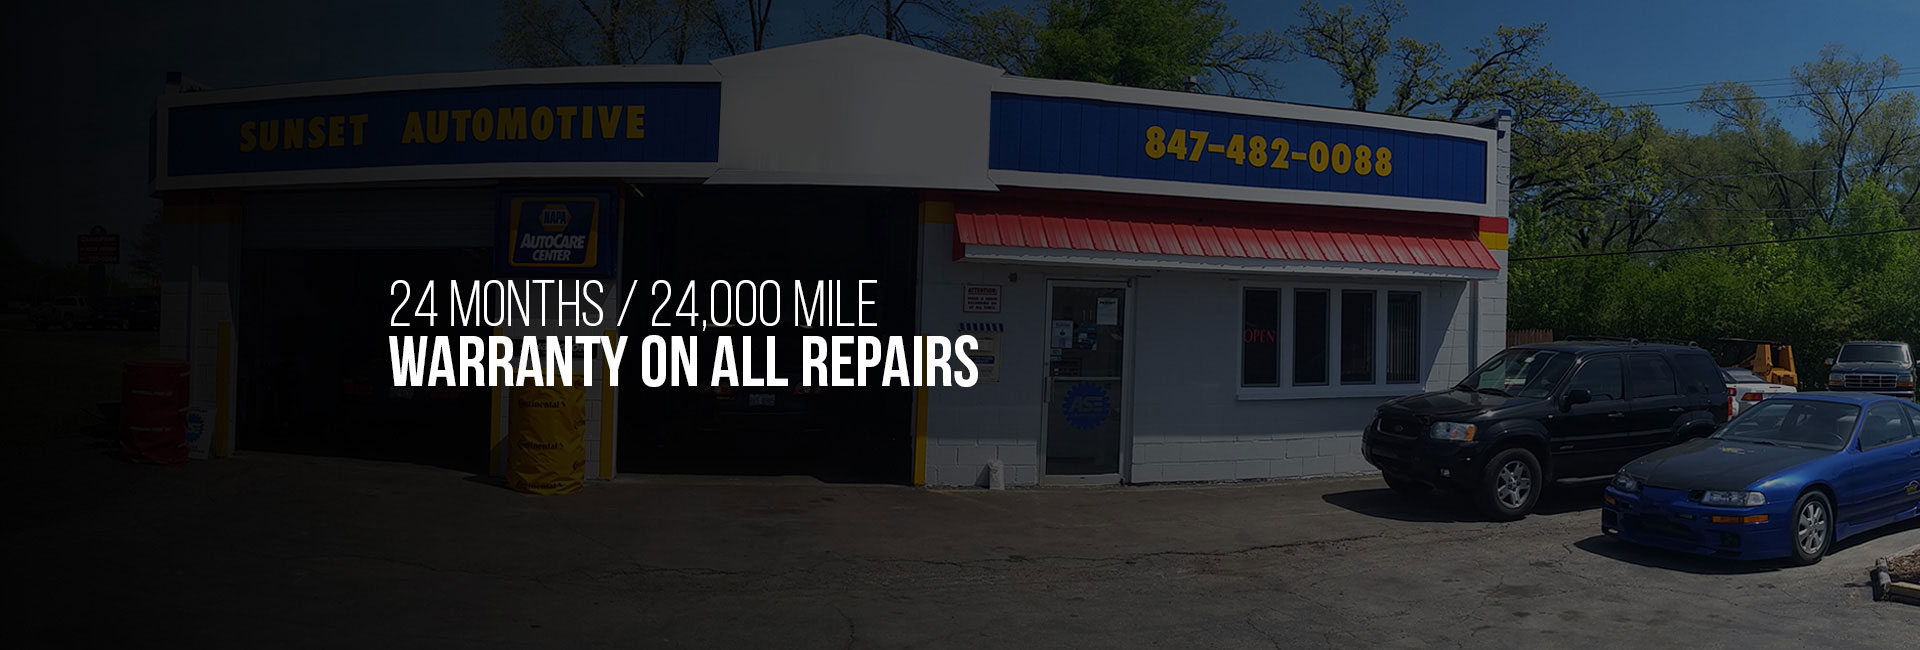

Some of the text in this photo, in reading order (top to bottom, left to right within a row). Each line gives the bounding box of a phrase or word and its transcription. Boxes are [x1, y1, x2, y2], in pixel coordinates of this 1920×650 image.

[239, 105, 646, 153] SUNSET AUTOMOTIVE
[1144, 125, 1394, 179] 847-482-0088
[543, 210, 567, 225] NAPA
[532, 249, 571, 262] CENTER
[1243, 327, 1277, 344] OPEN
